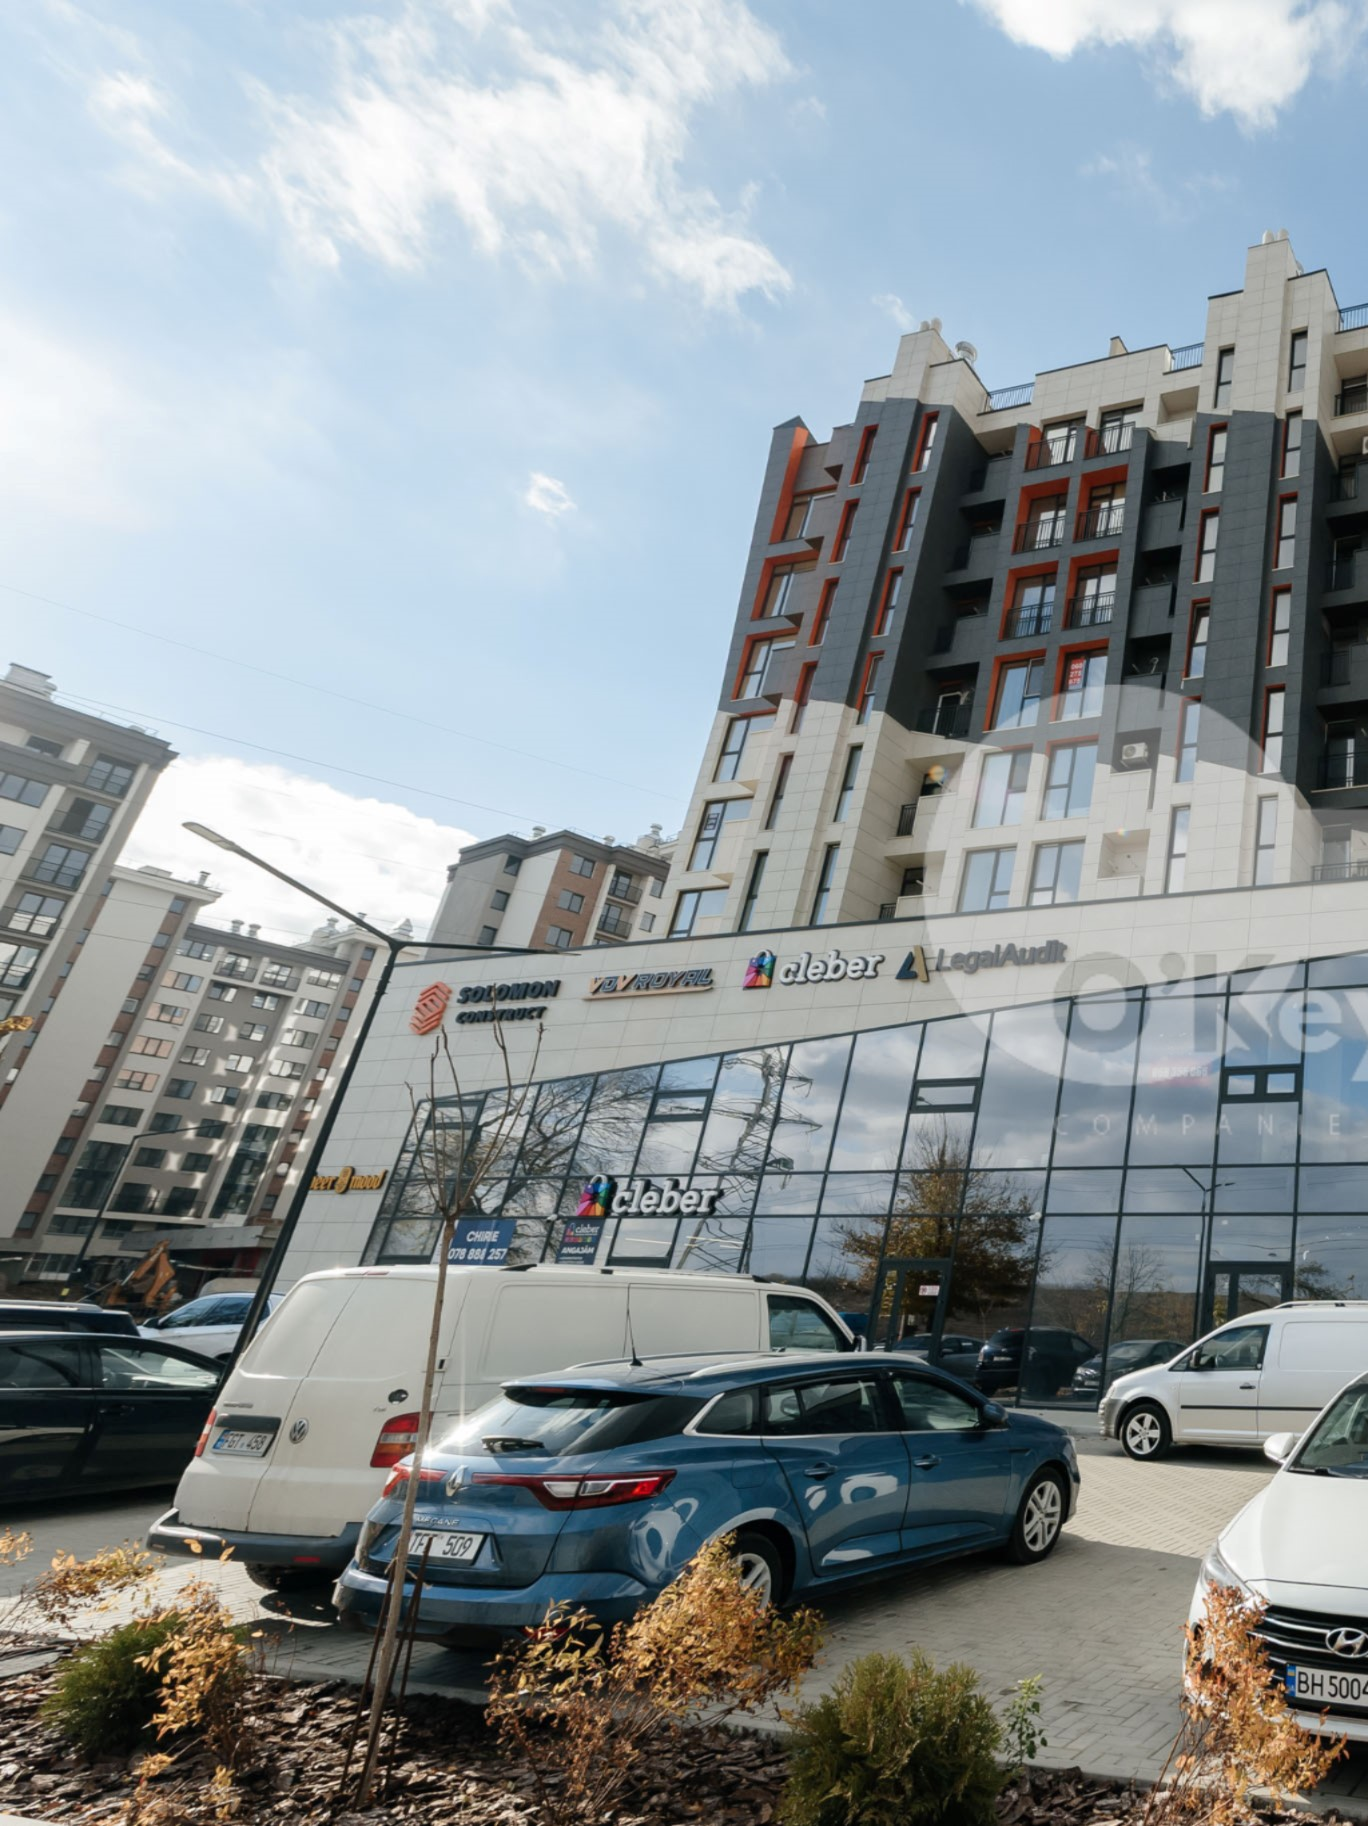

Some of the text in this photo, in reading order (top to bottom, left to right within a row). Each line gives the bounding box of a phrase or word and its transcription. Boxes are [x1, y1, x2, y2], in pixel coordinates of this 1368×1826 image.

[780, 949, 886, 986] cleber
[936, 940, 1068, 975] LegalAudit
[457, 980, 562, 1004] SOLOMON
[455, 1006, 547, 1024] CONSTRUCT
[310, 1169, 389, 1191] eer mood
[611, 1178, 720, 1215] cleber
[466, 1230, 500, 1242] CHIRIE
[442, 1535, 474, 1557] 509
[1298, 1671, 1324, 1697] BH
